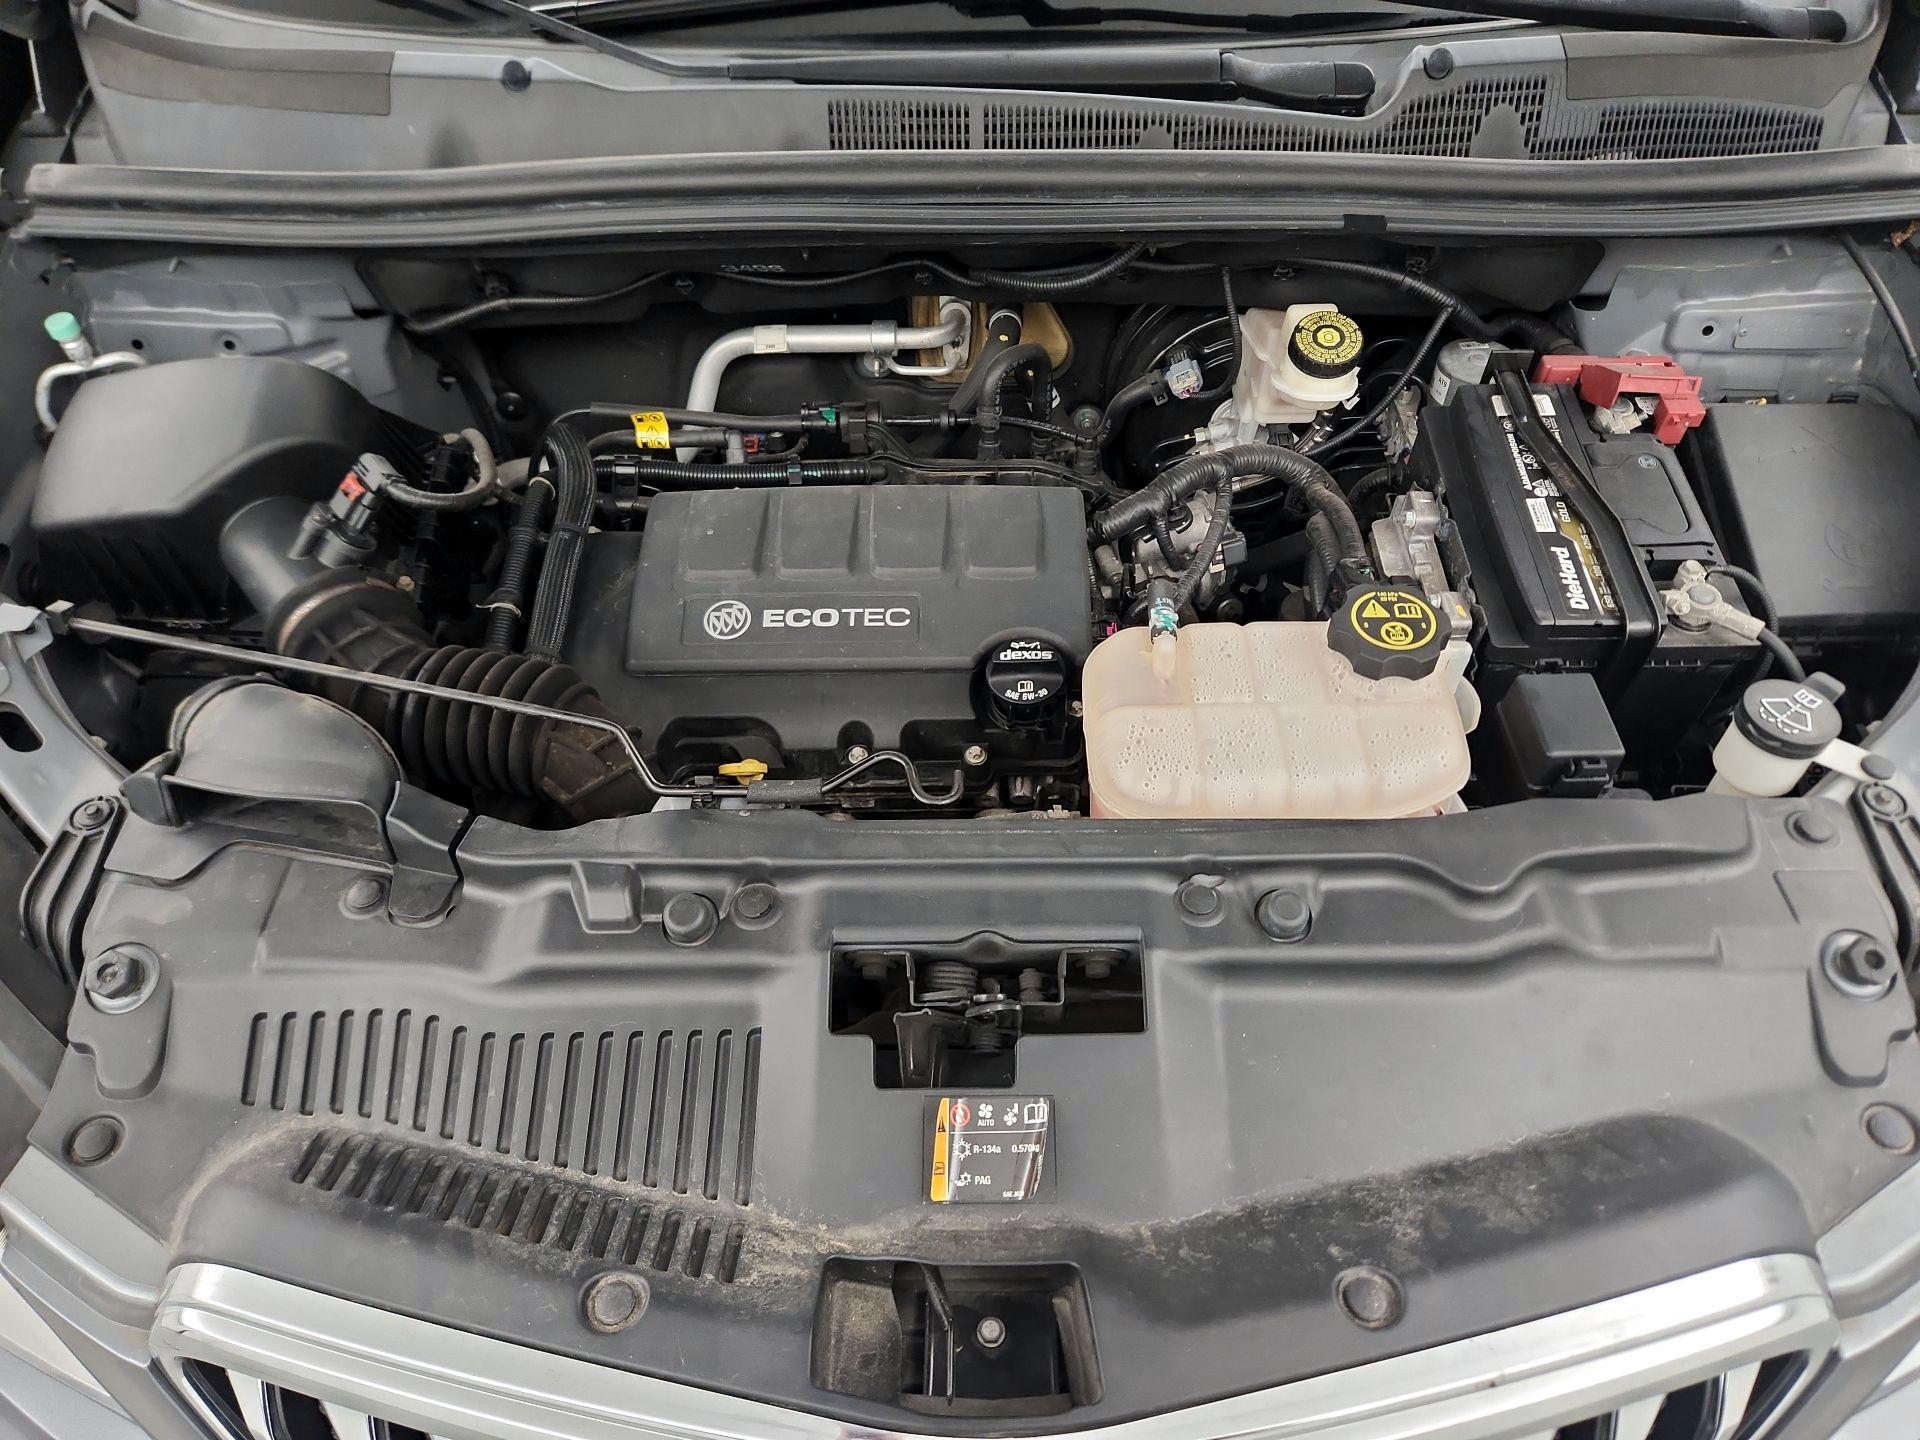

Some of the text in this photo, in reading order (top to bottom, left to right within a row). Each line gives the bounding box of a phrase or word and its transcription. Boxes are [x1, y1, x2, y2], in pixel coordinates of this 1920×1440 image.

[1556, 501, 1571, 523] GOLD
[1550, 546, 1590, 610] DieHard
[762, 608, 911, 628] ECOTEC
[1000, 649, 1053, 660] dexos
[1005, 688, 1049, 700] SAE 5W-30
[977, 1119, 995, 1127] AUTO
[973, 1144, 1001, 1153] R-134a
[974, 1175, 992, 1185] PAG
